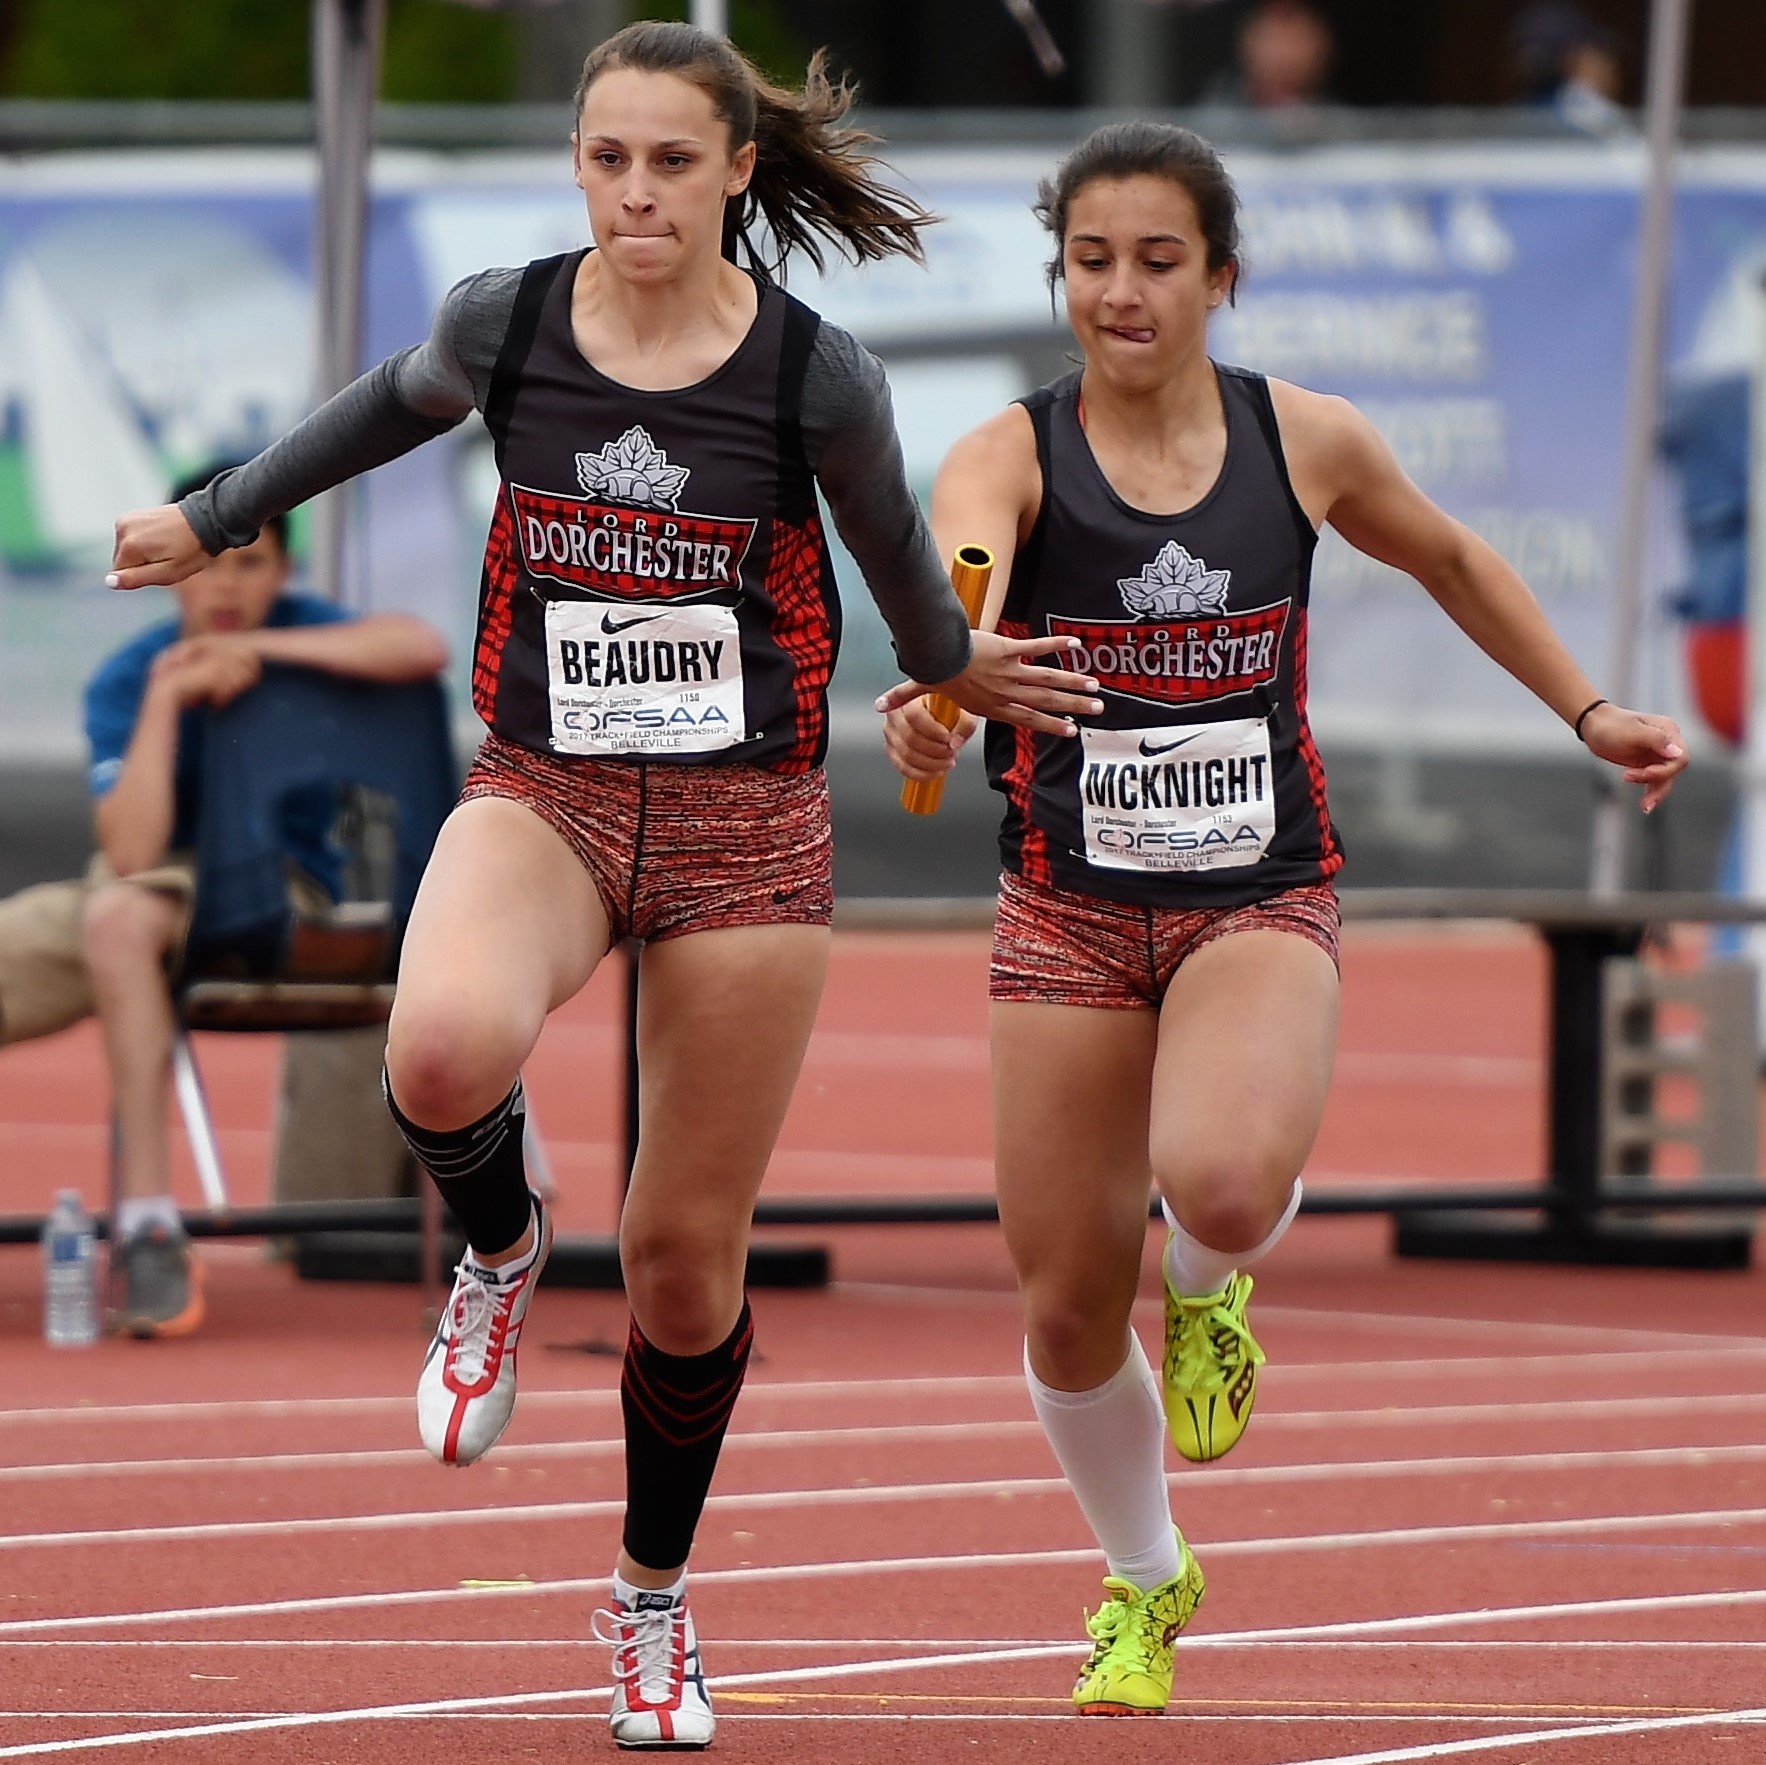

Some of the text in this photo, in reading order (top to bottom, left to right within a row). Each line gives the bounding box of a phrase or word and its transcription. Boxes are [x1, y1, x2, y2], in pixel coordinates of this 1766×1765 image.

[577, 509, 678, 536] LORD
[526, 515, 731, 582] DORCHESTER
[1126, 625, 1230, 643] LORD
[560, 640, 724, 687] BEAUDRY
[1070, 630, 1275, 680] DORCHESTER
[563, 704, 729, 731] OFSAA
[610, 738, 682, 749] BELLEVILLE
[652, 727, 729, 738] CHAMPIONSHIPS
[1085, 754, 1267, 811] MCKNIGHT
[1212, 814, 1233, 825] 1153
[1096, 824, 1261, 851] OFSAA
[1186, 843, 1261, 859] CHAMPIONSHIPS
[1145, 856, 1214, 868] BELLEVILLE
